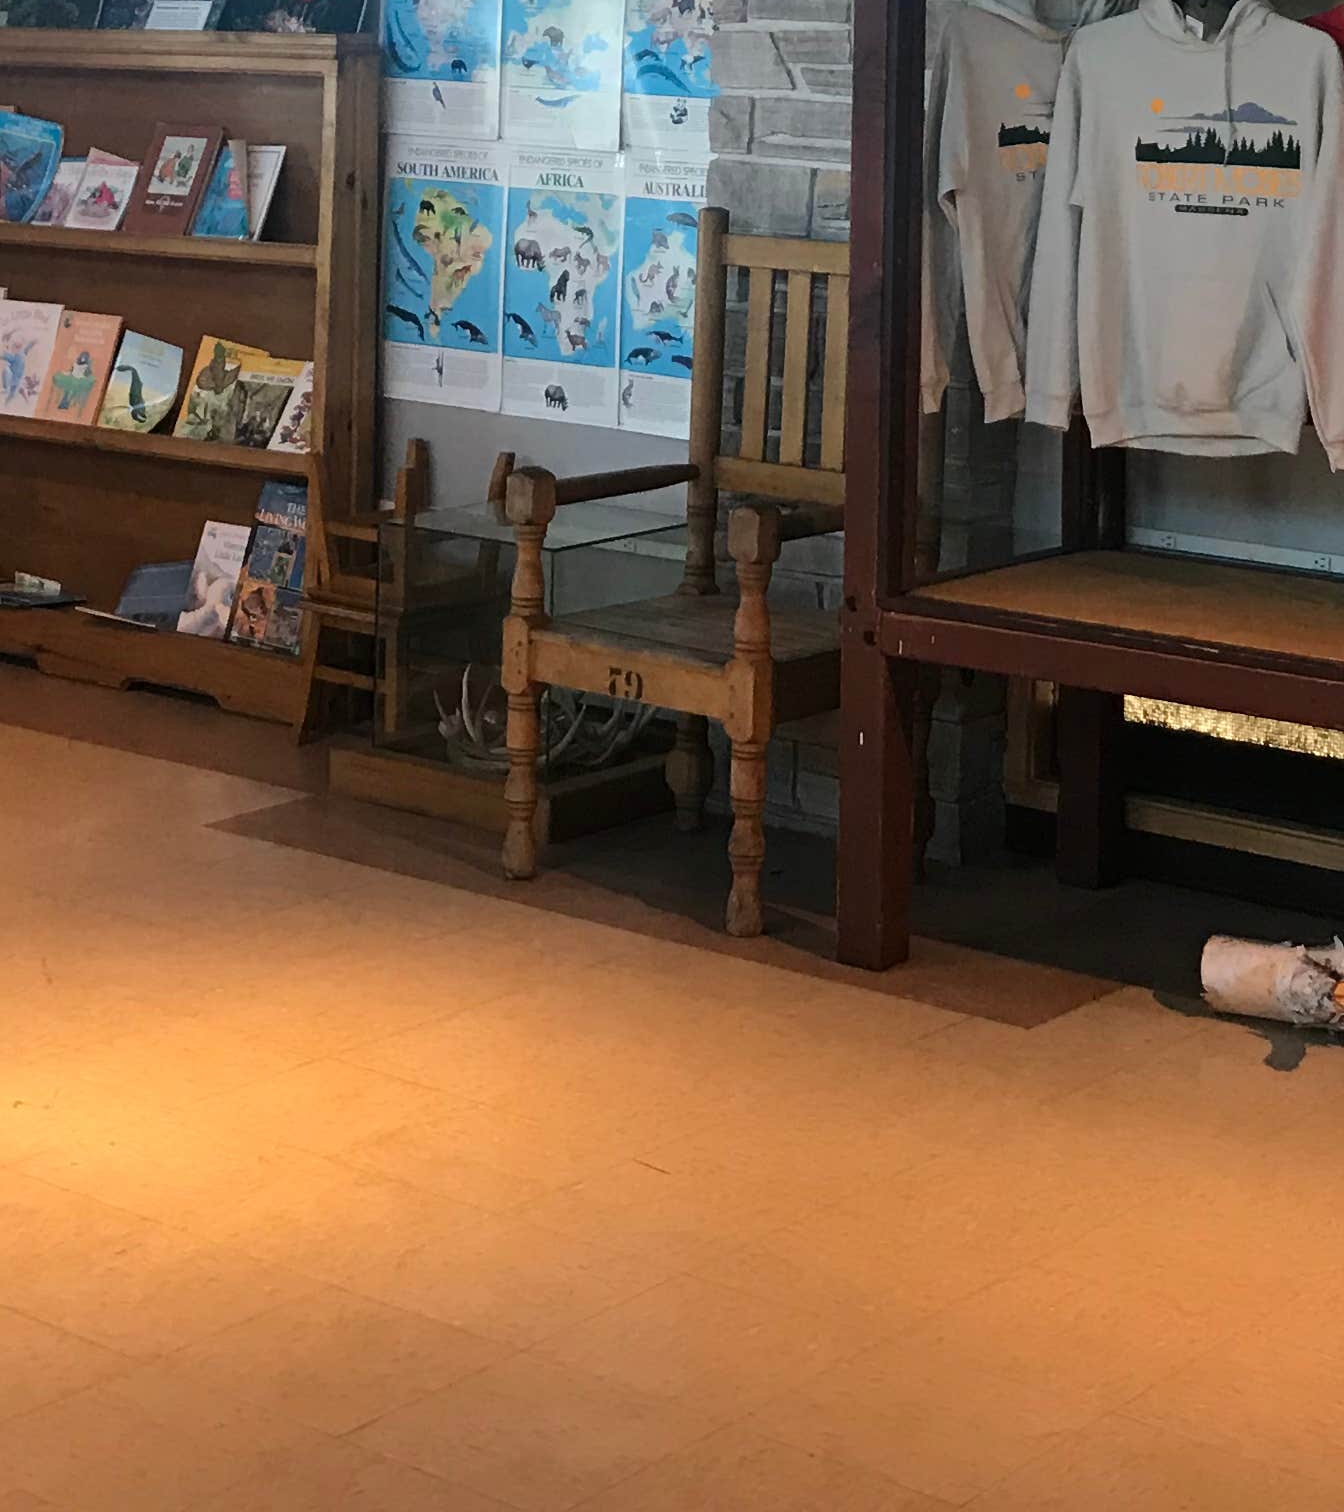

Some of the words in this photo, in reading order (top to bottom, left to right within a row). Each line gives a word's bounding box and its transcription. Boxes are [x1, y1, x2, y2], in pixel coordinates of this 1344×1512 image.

[397, 163, 439, 178] SOUTH
[441, 165, 499, 181] AMERICA
[536, 173, 584, 188] AFRICA
[643, 181, 706, 199] AUSTRALI
[1147, 191, 1208, 204] STATE
[1222, 194, 1286, 209] PARK
